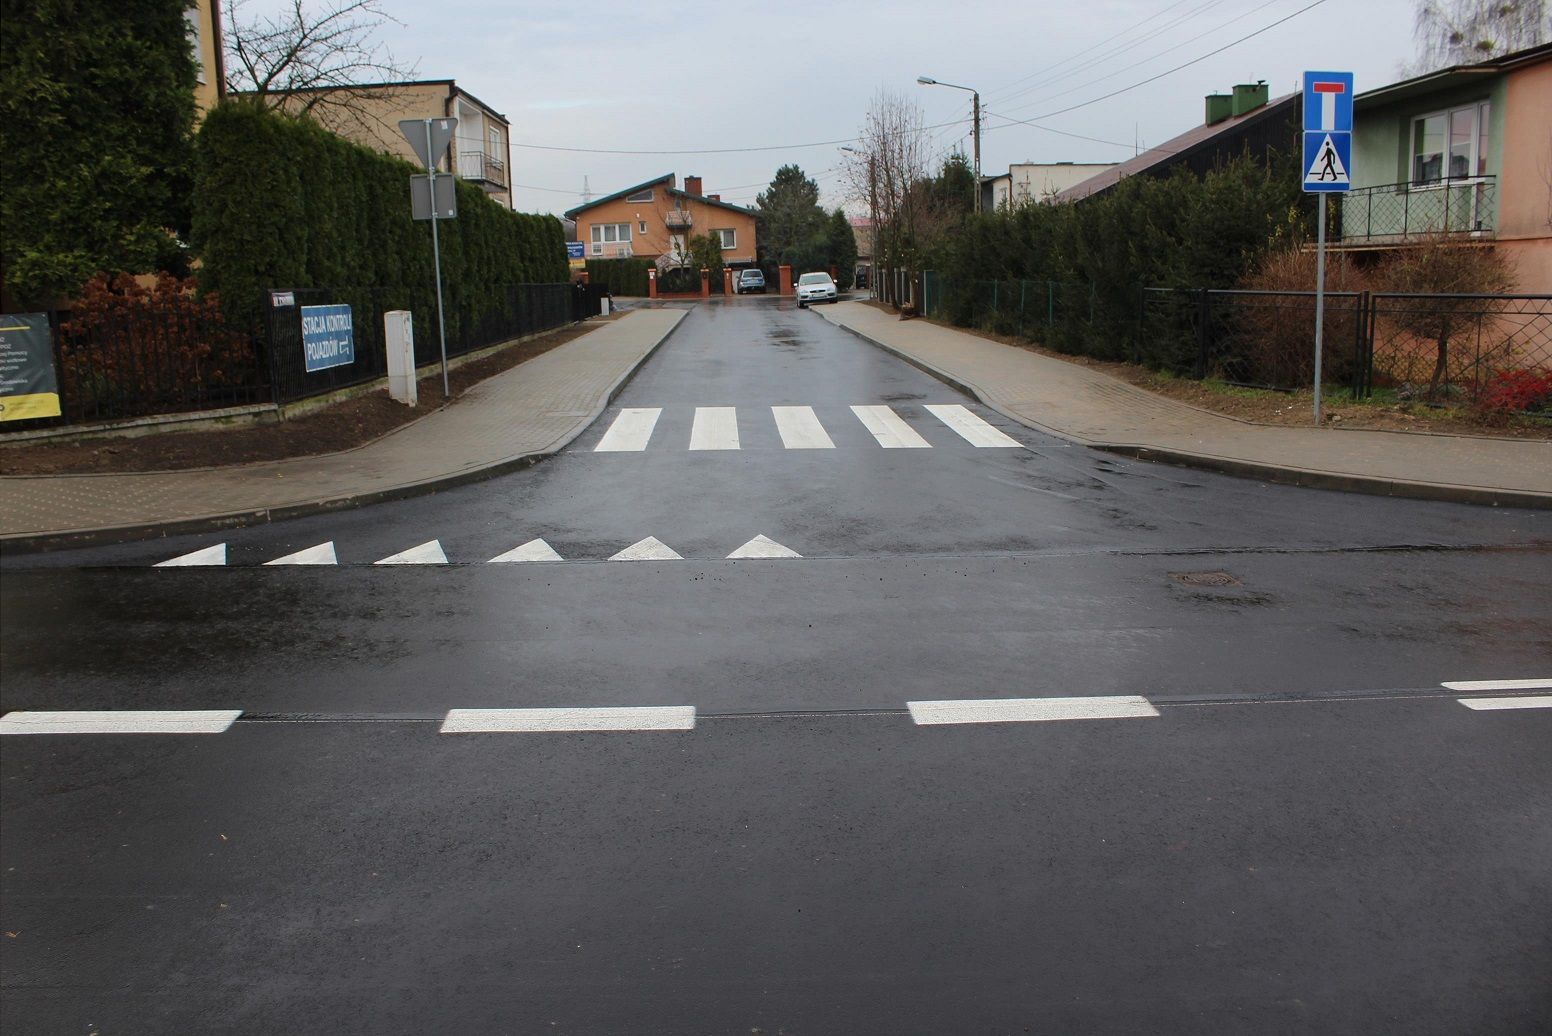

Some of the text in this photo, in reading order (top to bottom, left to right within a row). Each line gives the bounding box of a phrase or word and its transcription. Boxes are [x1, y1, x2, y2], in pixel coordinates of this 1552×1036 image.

[304, 314, 351, 335] STACJA KONTROLI
[307, 337, 338, 360] POJAZDÓW
